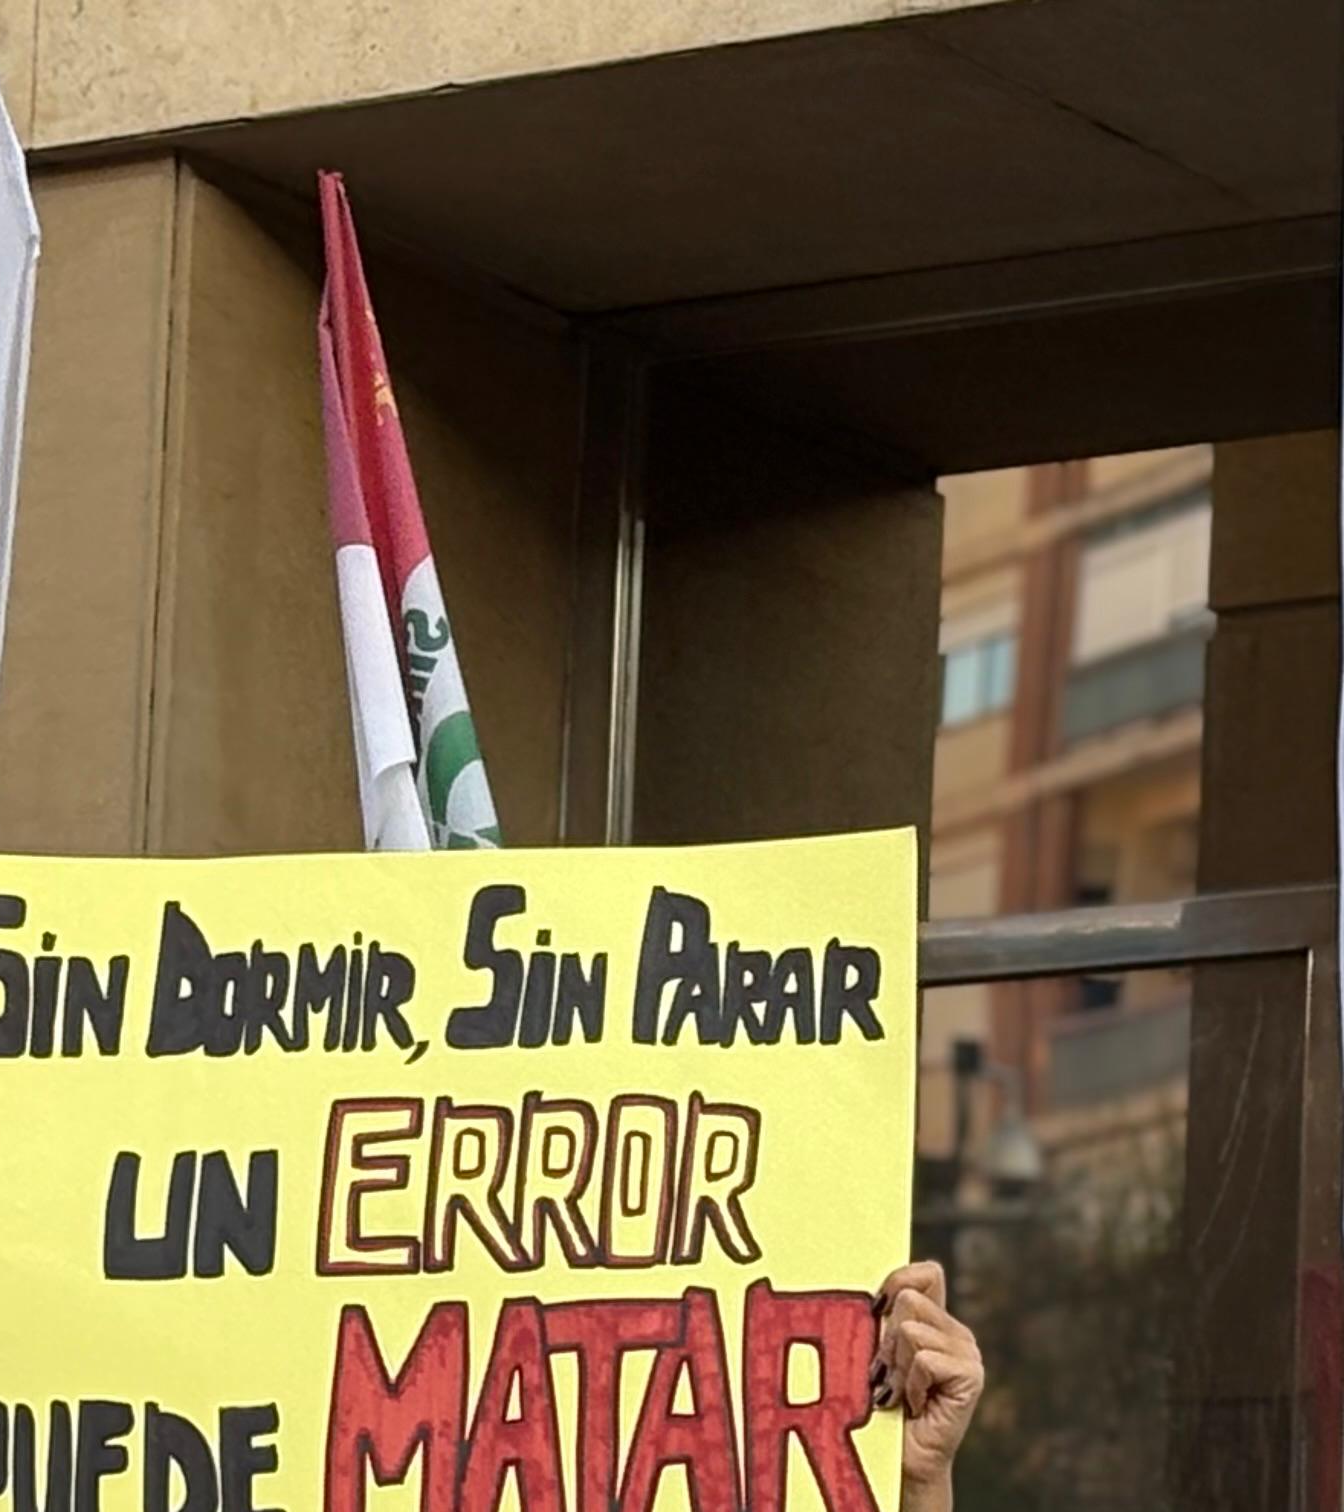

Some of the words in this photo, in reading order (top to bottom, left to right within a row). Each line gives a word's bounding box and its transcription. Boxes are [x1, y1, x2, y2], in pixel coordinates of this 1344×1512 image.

[632, 886, 885, 1049] PARAR
[104, 1150, 278, 1280] UN
[316, 1090, 762, 1277] ERROR
